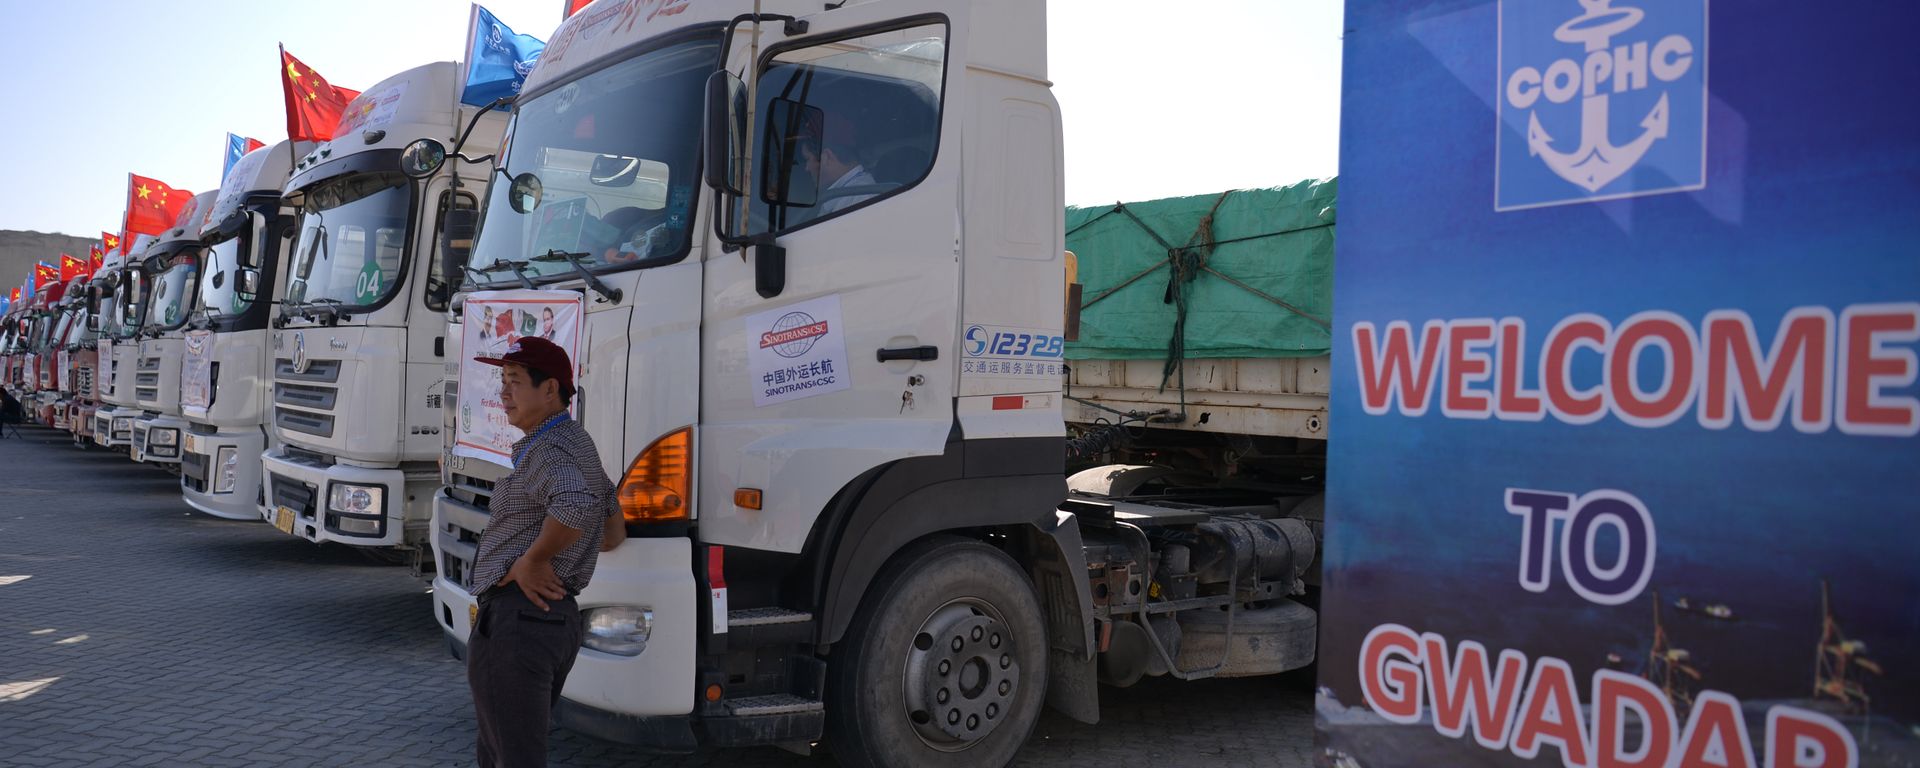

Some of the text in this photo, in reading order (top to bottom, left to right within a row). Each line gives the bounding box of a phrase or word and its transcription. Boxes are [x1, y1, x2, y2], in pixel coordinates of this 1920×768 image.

[1506, 34, 1694, 109] COPHC
[356, 270, 379, 298] 04
[763, 359, 834, 387] 中国外运长航
[765, 375, 836, 398] SINOTRANS&CSC
[1353, 303, 1920, 436] WELCOME
[1505, 487, 1656, 605] TO
